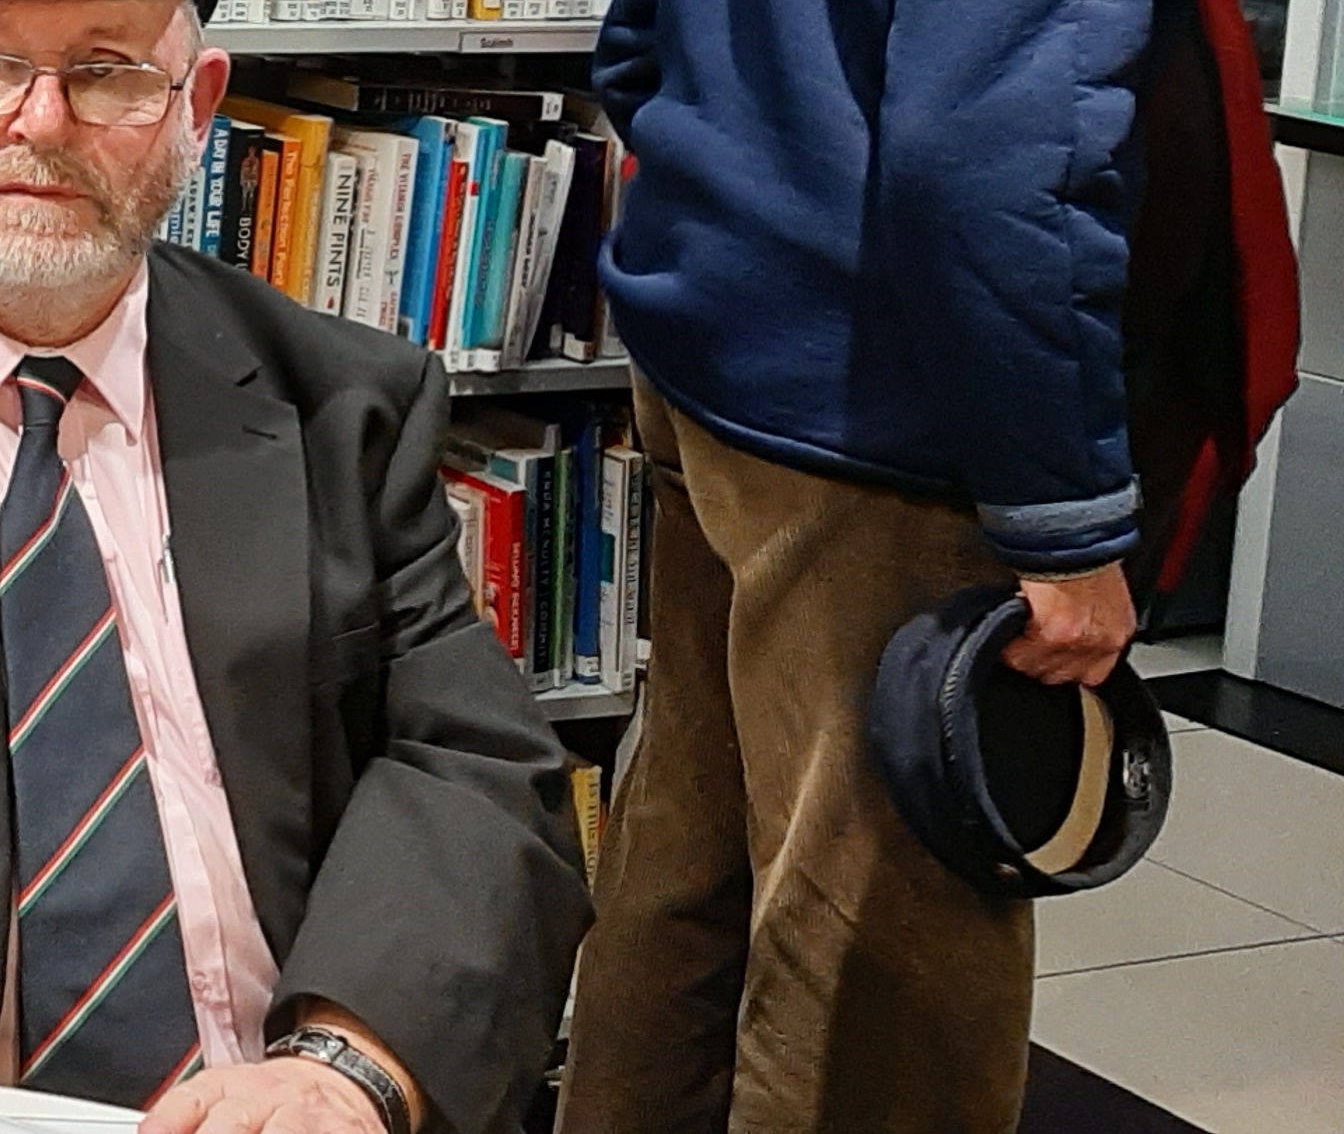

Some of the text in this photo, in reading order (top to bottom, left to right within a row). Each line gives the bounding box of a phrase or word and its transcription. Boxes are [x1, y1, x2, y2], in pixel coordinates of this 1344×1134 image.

[214, 139, 225, 159] DAY
[285, 151, 297, 175] The
[212, 162, 224, 173] IN
[209, 177, 223, 207] YOUR
[206, 211, 221, 237] LIFE
[278, 178, 295, 248] Perfection
[236, 217, 251, 259] BODY
[326, 174, 351, 288] NINE PINTS
